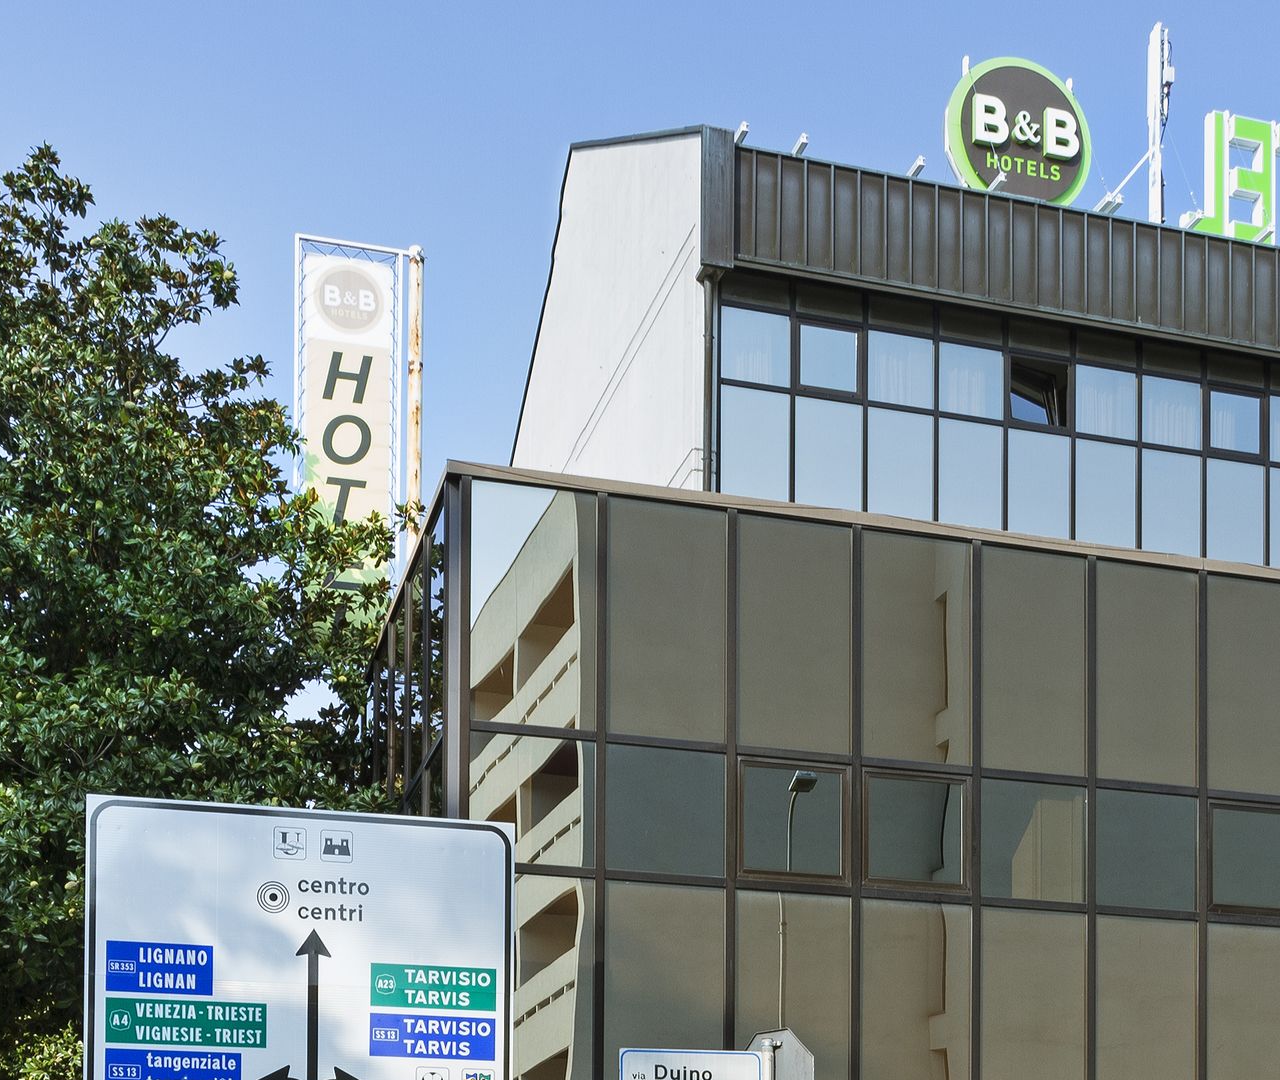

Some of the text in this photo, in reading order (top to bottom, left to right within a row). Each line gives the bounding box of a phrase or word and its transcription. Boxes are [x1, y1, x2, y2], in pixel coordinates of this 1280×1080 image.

[972, 93, 1081, 160] B&B
[986, 151, 1062, 182] HOTELS
[324, 284, 376, 312] B&B
[330, 308, 369, 321] HOTELS
[322, 351, 373, 527] HOT
[297, 877, 370, 896] centro
[297, 903, 364, 922] centri
[138, 947, 208, 966] LIGNANO
[138, 972, 196, 990] LIGNAN
[377, 979, 394, 989] A23
[404, 969, 491, 987] TARVISIO
[404, 990, 471, 1006] TARVIS
[135, 1003, 197, 1020] VENEZIA
[207, 1005, 263, 1022] TRIESTE
[135, 1025, 202, 1042] VIGNESIE
[215, 1028, 262, 1044] TRIEST
[387, 1030, 396, 1039] 13
[403, 1018, 491, 1037] TARVISIO
[403, 1039, 471, 1057] TARVIS
[146, 1052, 237, 1071] tangenziale
[112, 1066, 137, 1077] SS 13
[632, 1070, 646, 1080] via
